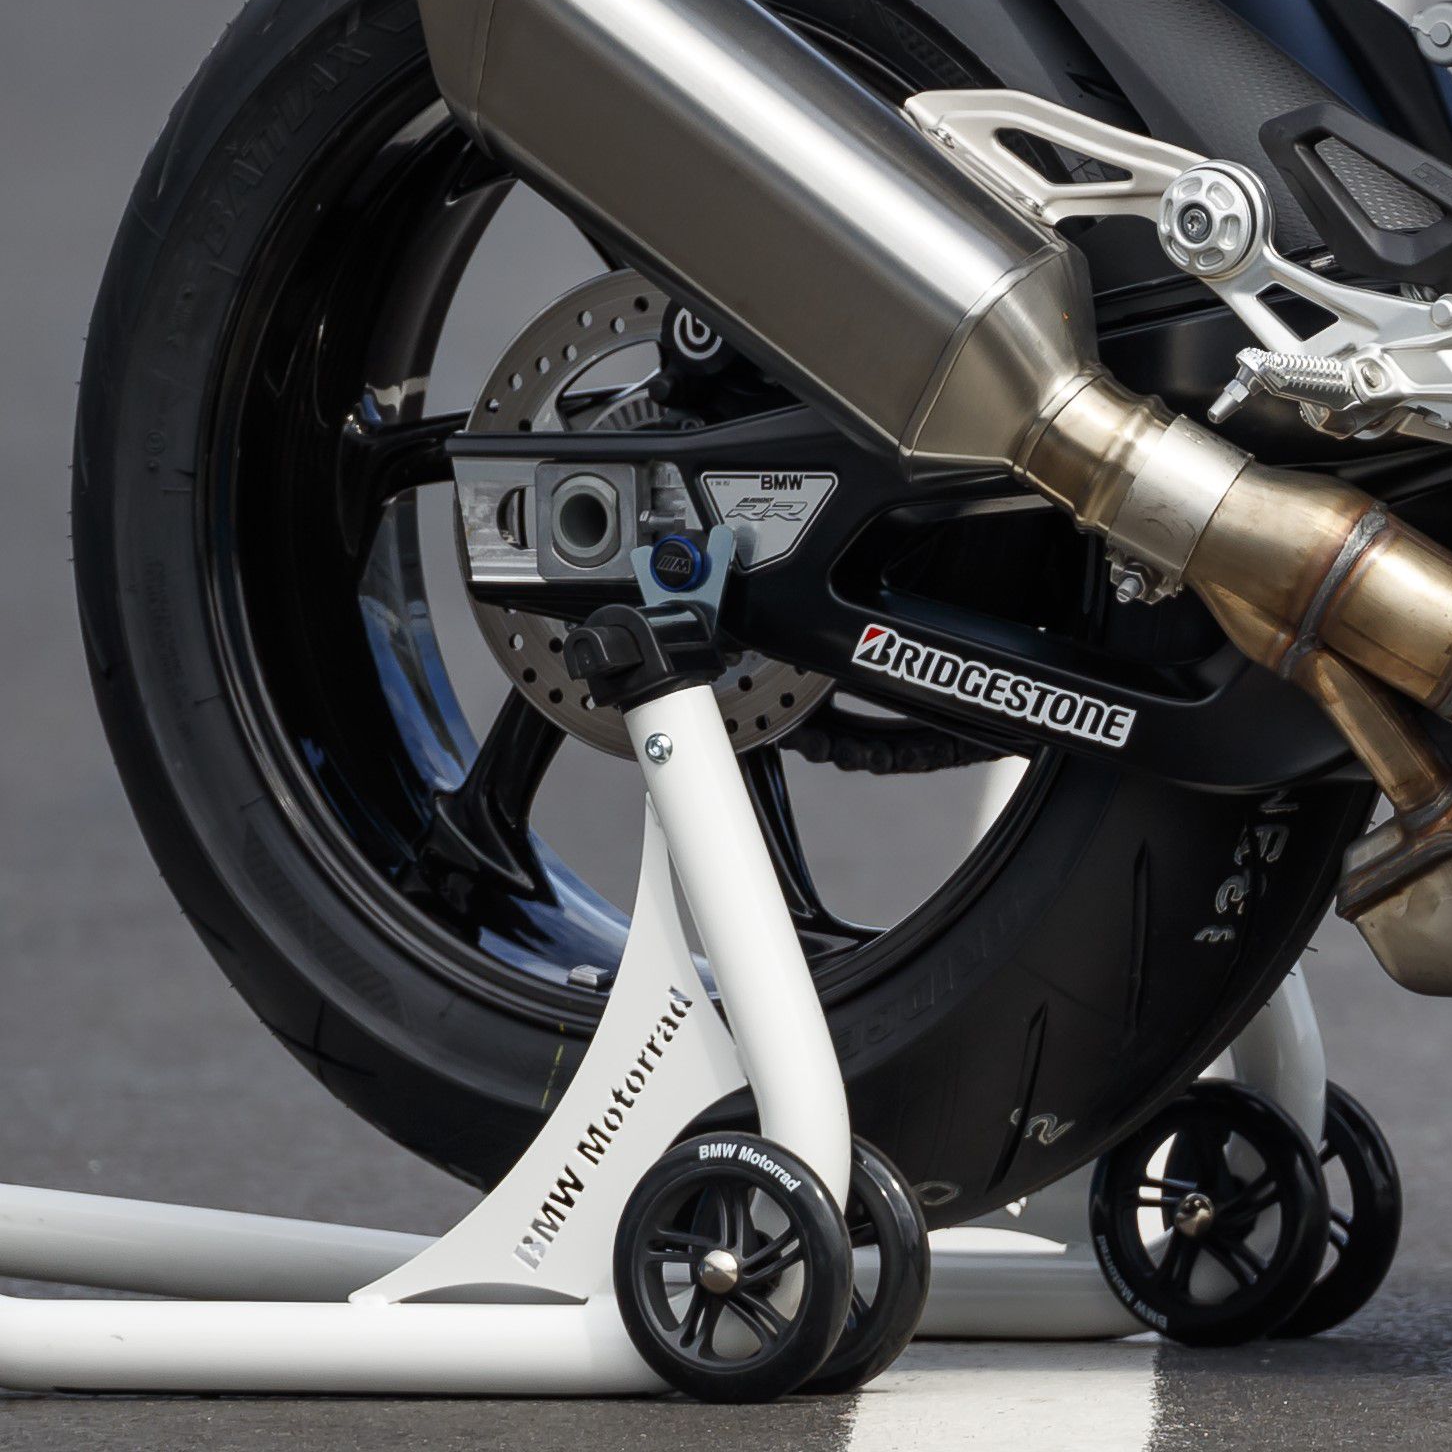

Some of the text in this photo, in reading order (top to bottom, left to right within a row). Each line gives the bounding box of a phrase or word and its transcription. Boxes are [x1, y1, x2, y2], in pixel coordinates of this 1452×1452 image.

[761, 474, 803, 490] BMW
[856, 626, 1131, 742] BRIDGESTONE
[512, 986, 694, 1273] BMW Motorrad
[699, 1144, 801, 1193] BMW Motorrad
